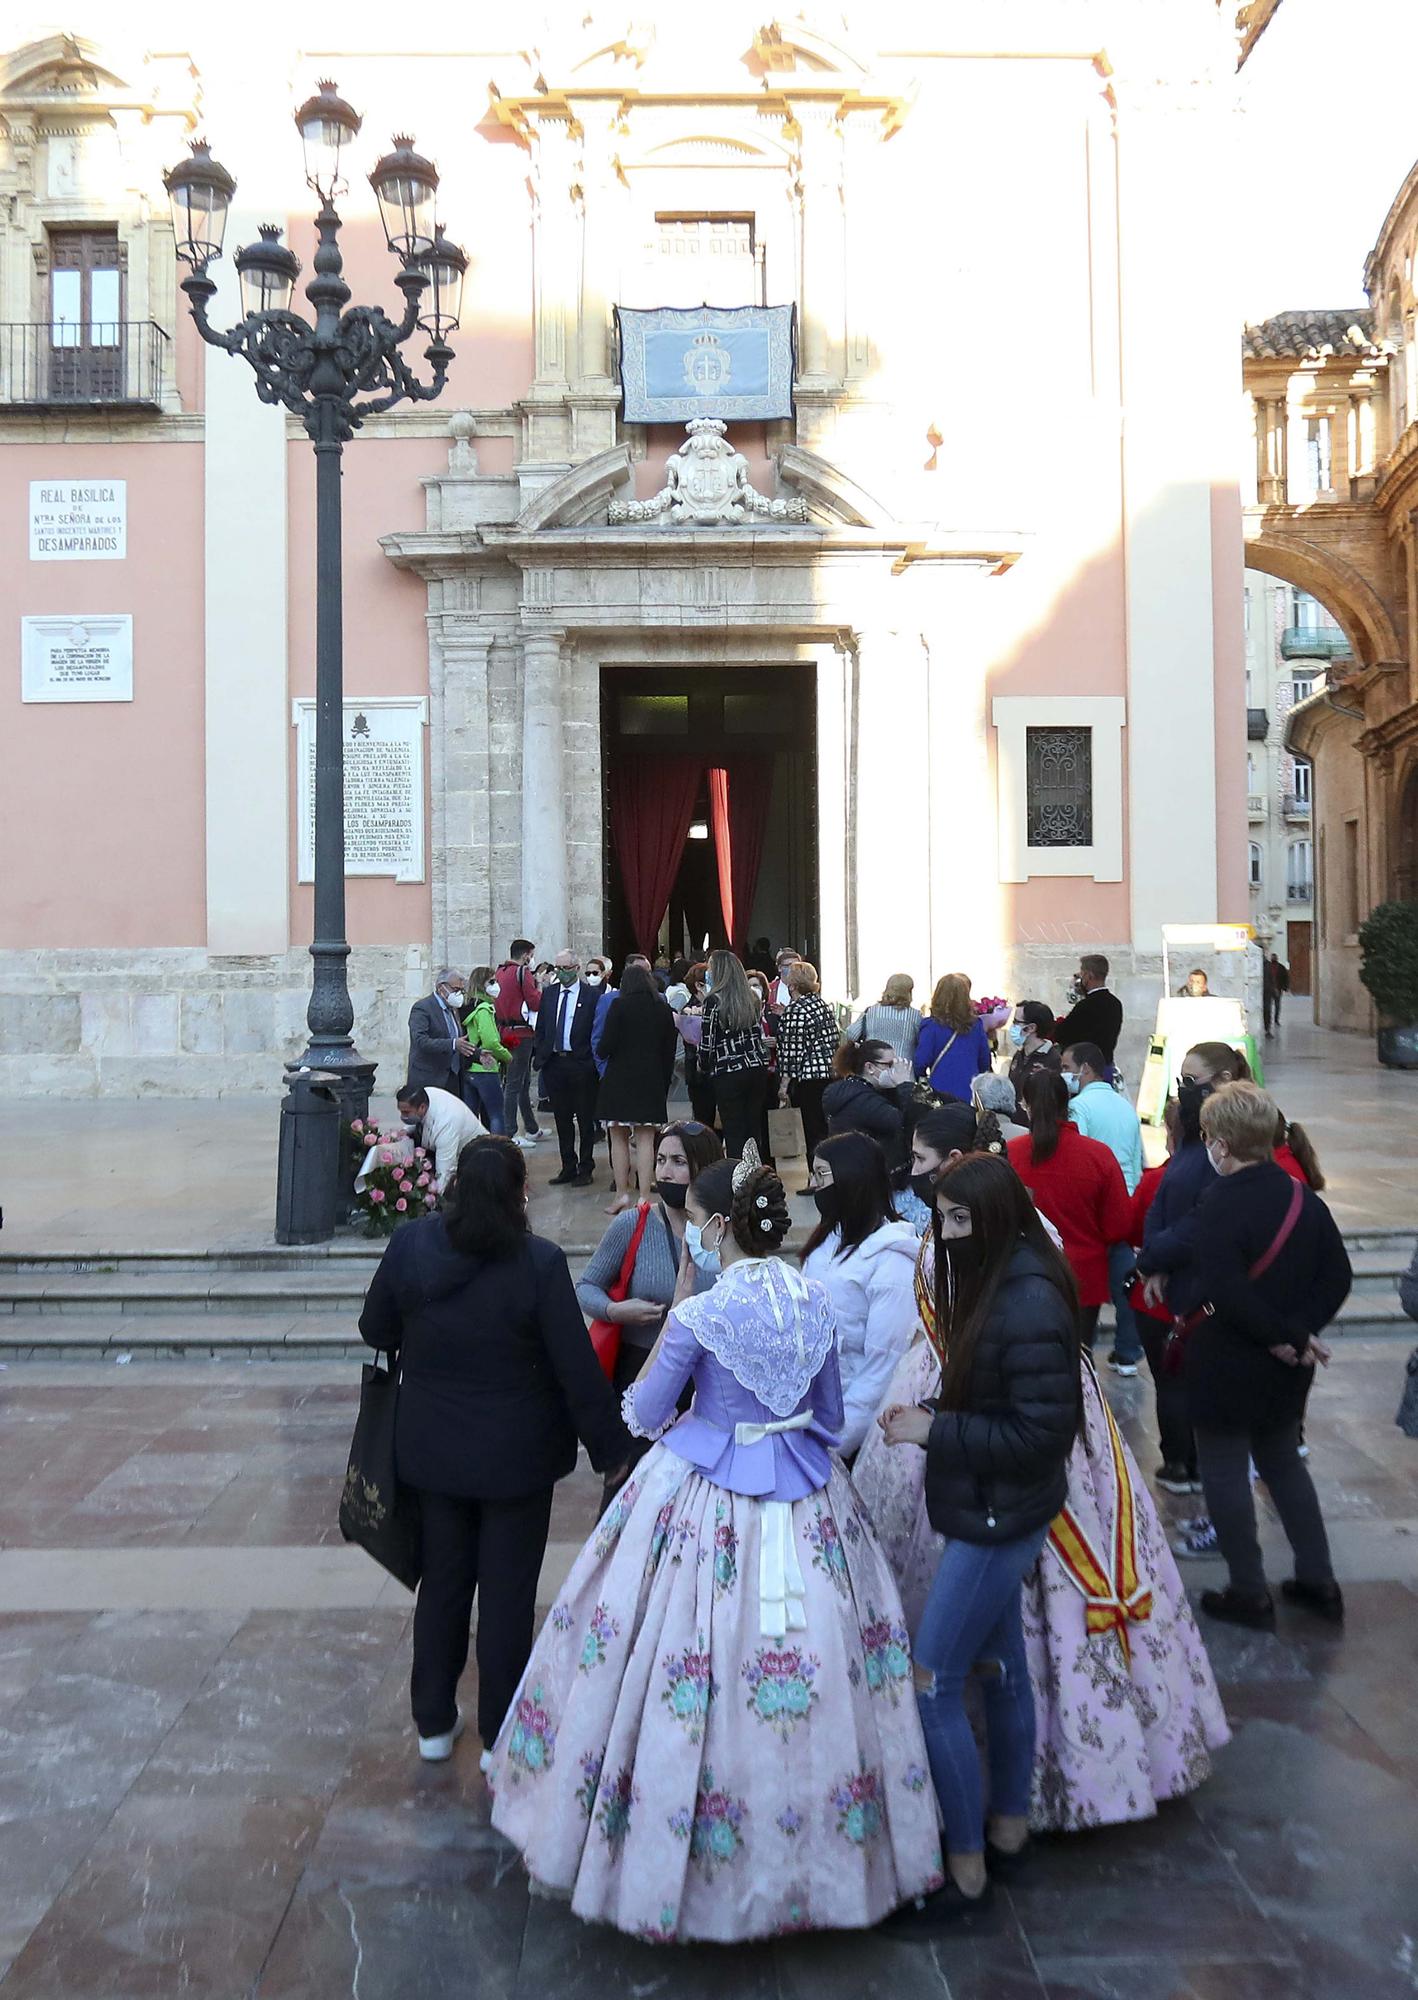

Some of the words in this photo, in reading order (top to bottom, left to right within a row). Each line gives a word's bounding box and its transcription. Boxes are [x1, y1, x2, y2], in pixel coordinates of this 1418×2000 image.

[40, 489, 65, 503] REAL
[71, 488, 115, 502] BASILICA
[58, 512, 91, 524] SEÑORA
[38, 538, 117, 551] DESAMPARADOS
